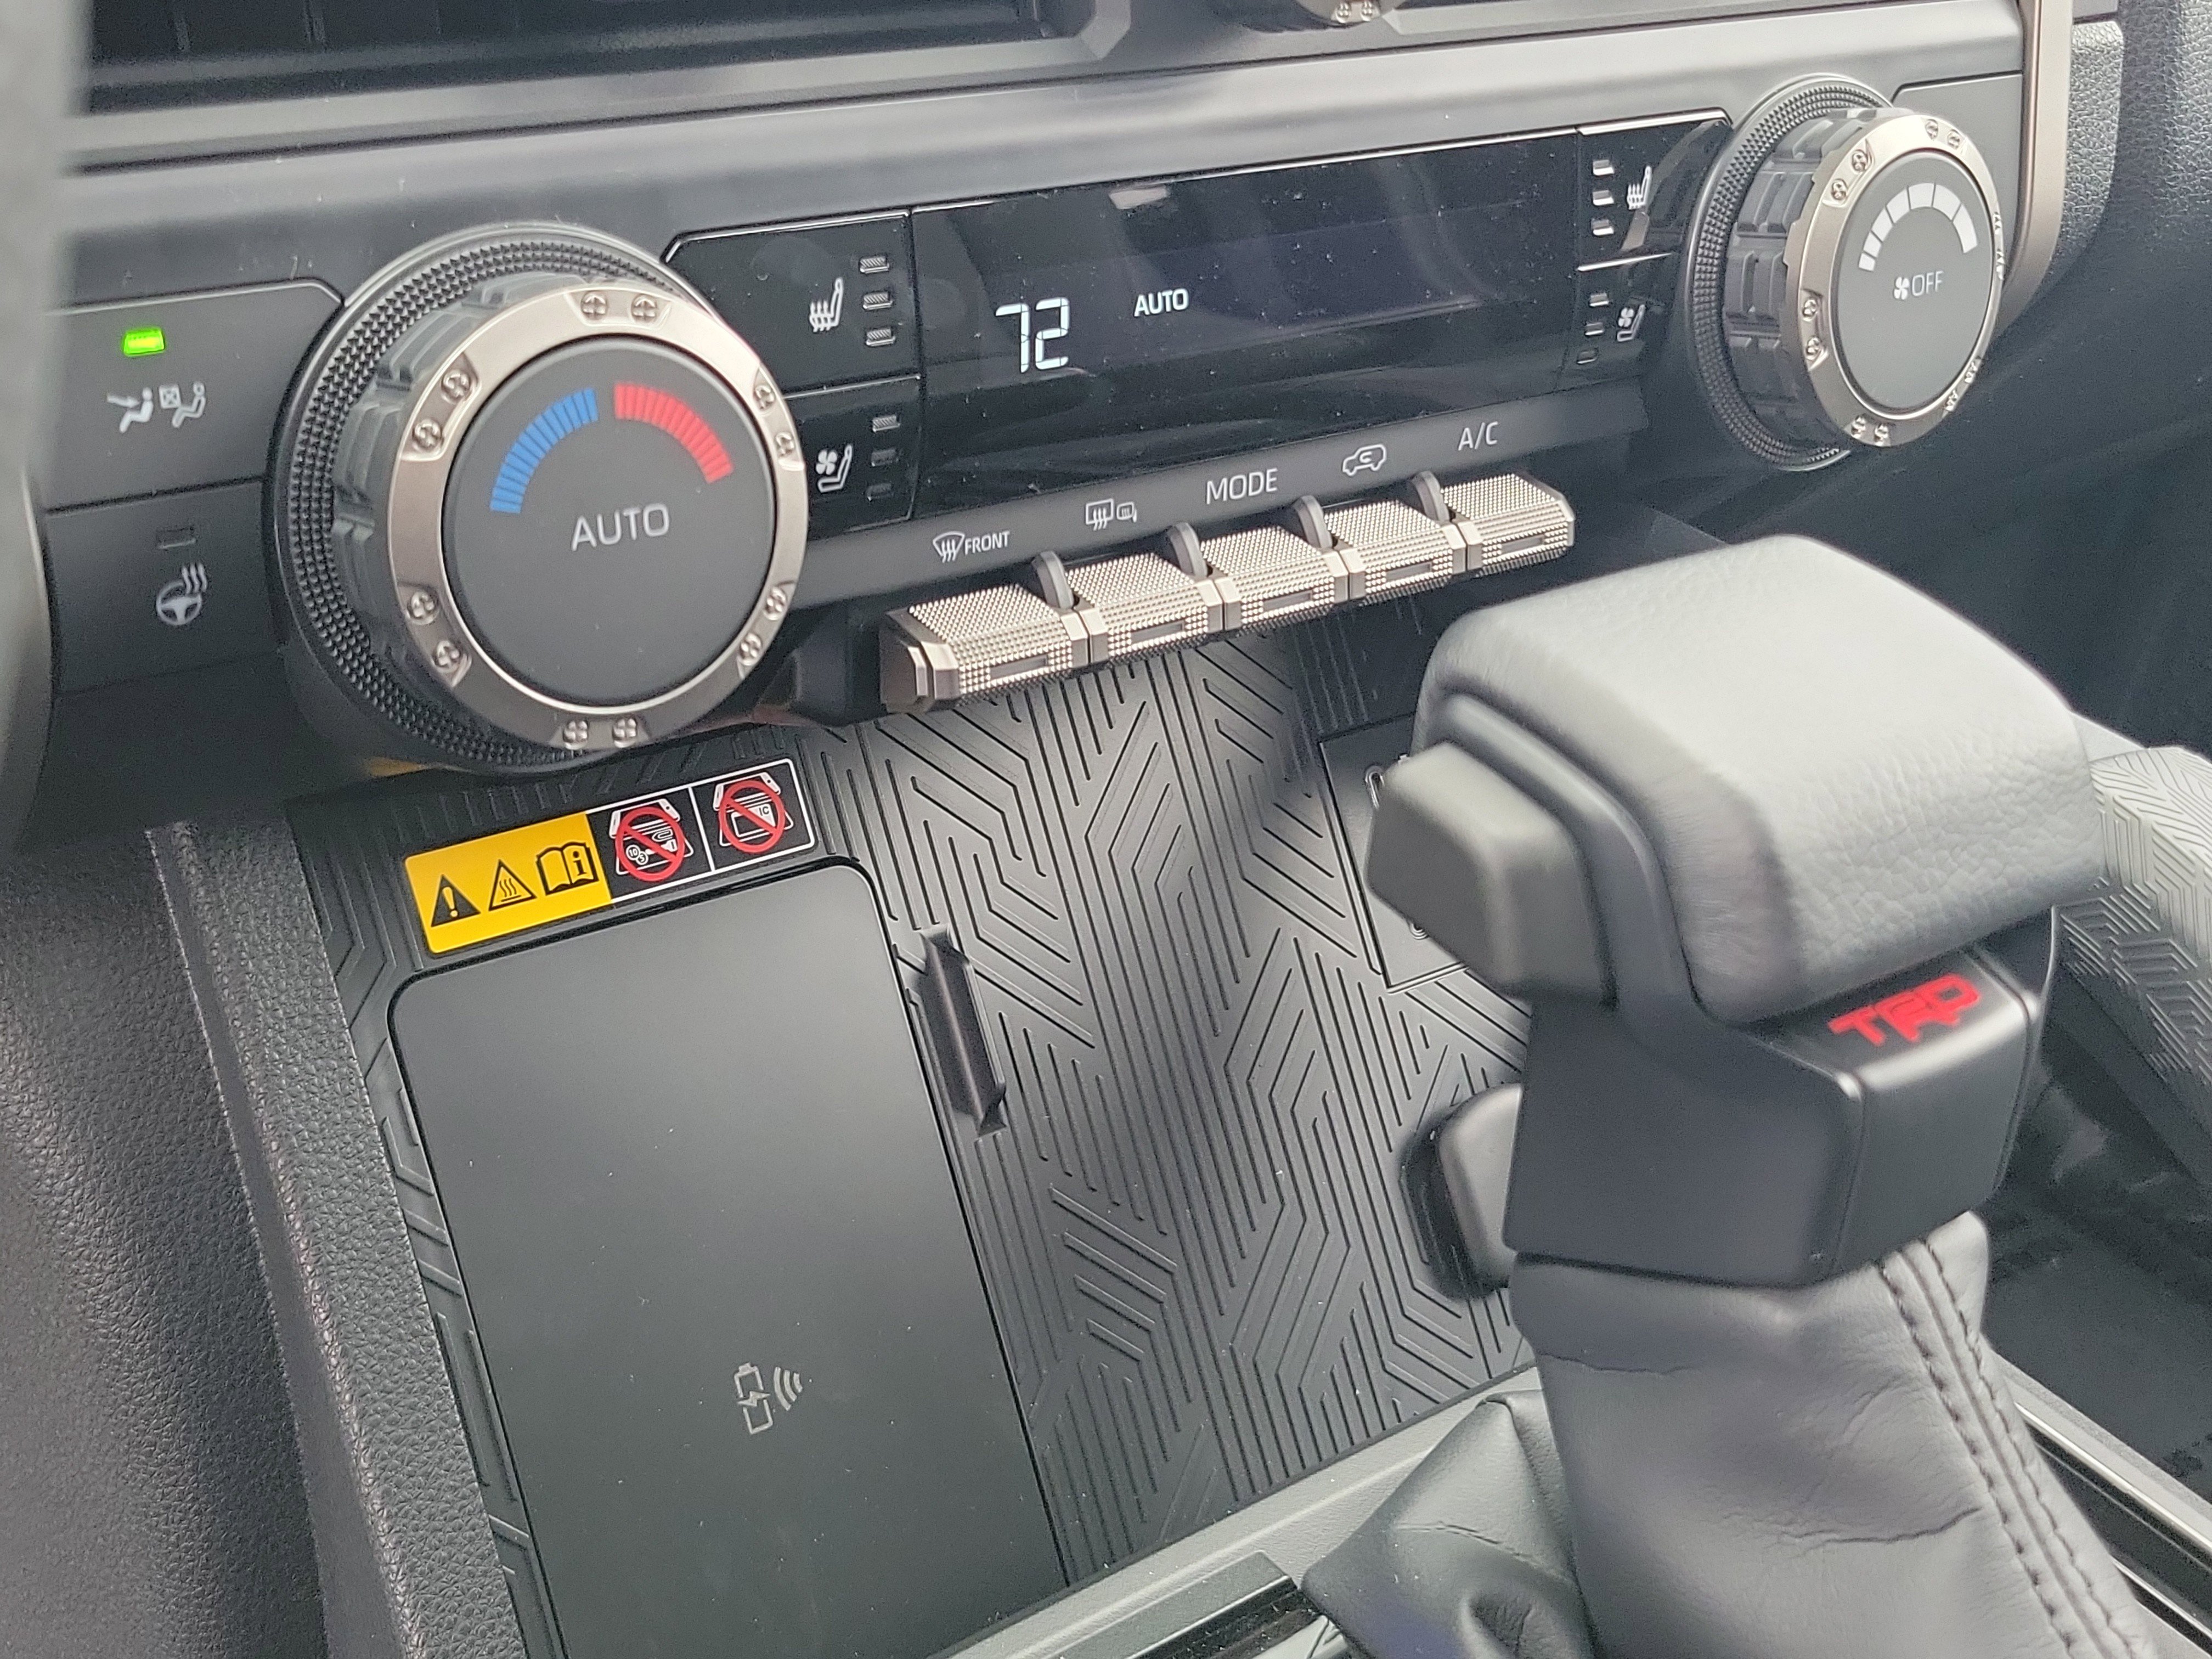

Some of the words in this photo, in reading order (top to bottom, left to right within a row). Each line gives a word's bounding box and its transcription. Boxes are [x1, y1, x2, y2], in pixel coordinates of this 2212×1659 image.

[1911, 270, 1944, 297] OFF
[1134, 288, 1189, 317] AUTO
[995, 297, 1070, 373] 72
[1457, 421, 1499, 451] A/C
[1206, 468, 1278, 504] MODE
[571, 503, 670, 551] AUTO
[964, 531, 1011, 555] FRONT
[759, 806, 770, 816] IC
[629, 848, 638, 857] 10
[1827, 973, 1980, 1046] TRD
